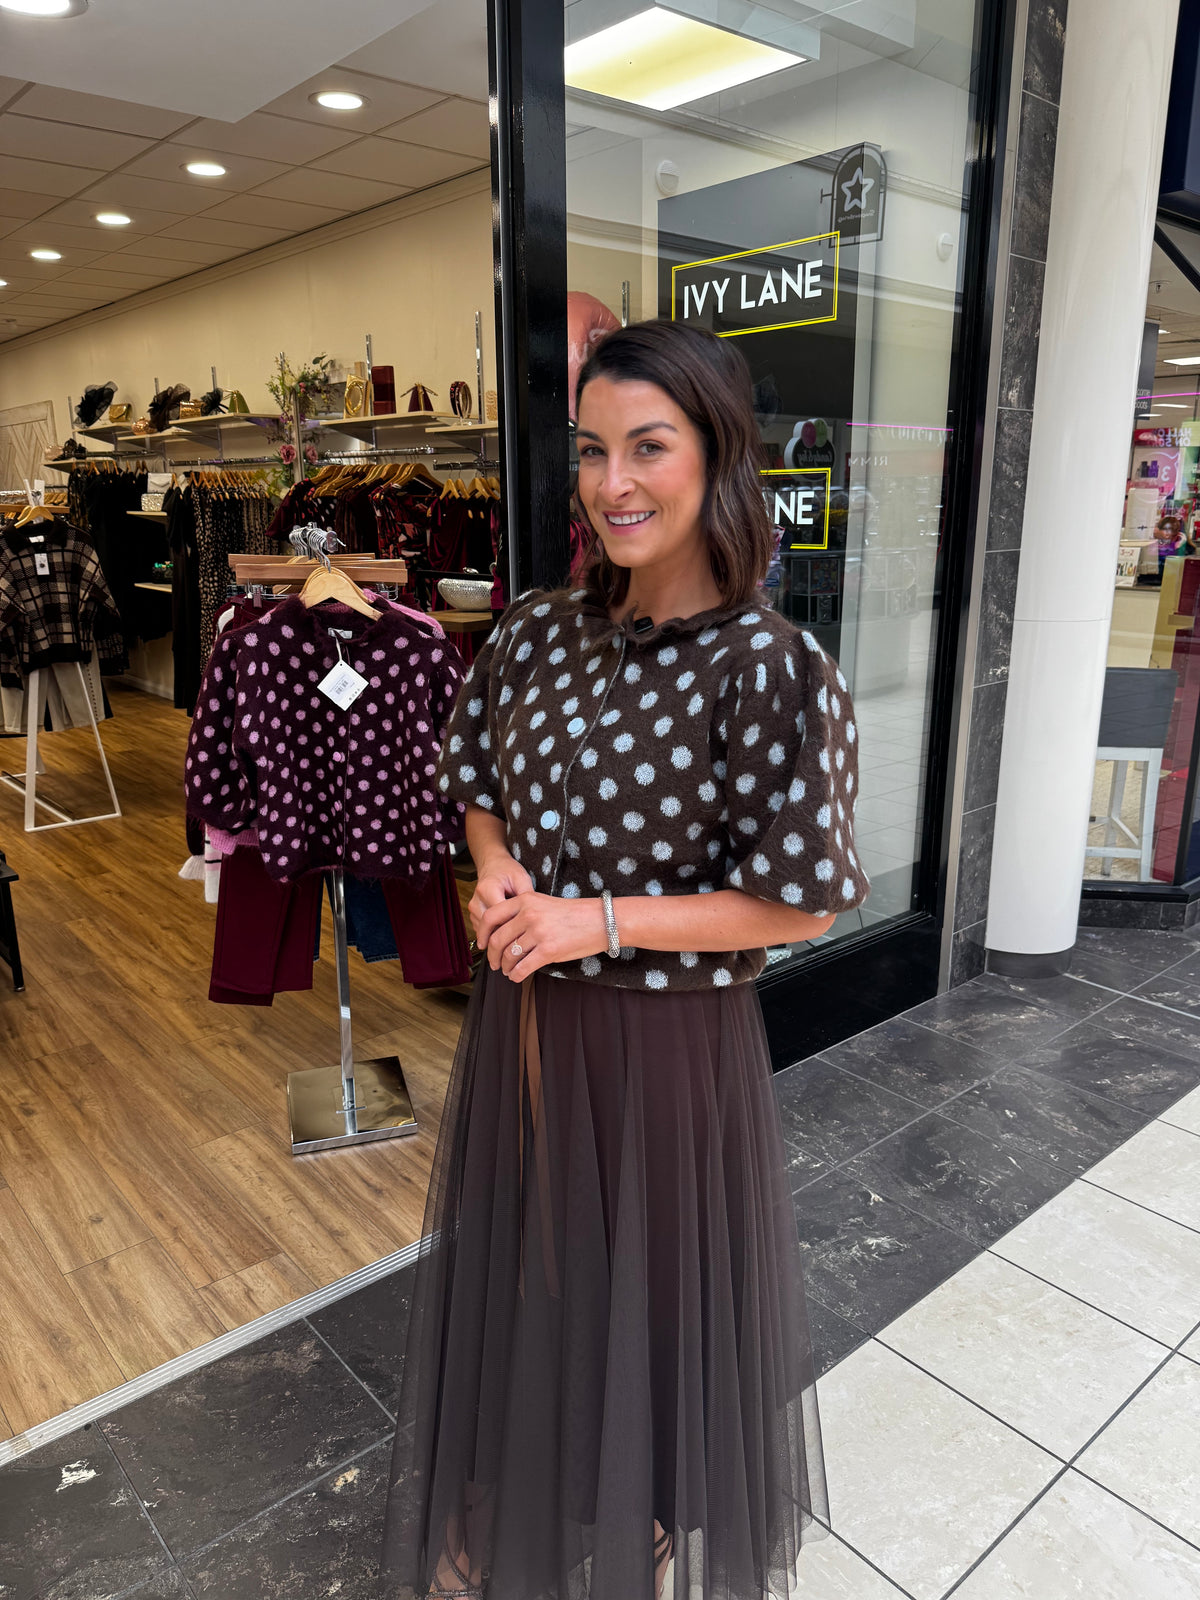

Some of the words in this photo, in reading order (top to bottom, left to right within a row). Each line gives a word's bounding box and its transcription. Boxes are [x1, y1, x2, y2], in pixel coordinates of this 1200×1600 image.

[684, 278, 730, 319] IVY
[741, 259, 823, 309] LANE
[762, 491, 815, 525] NE
